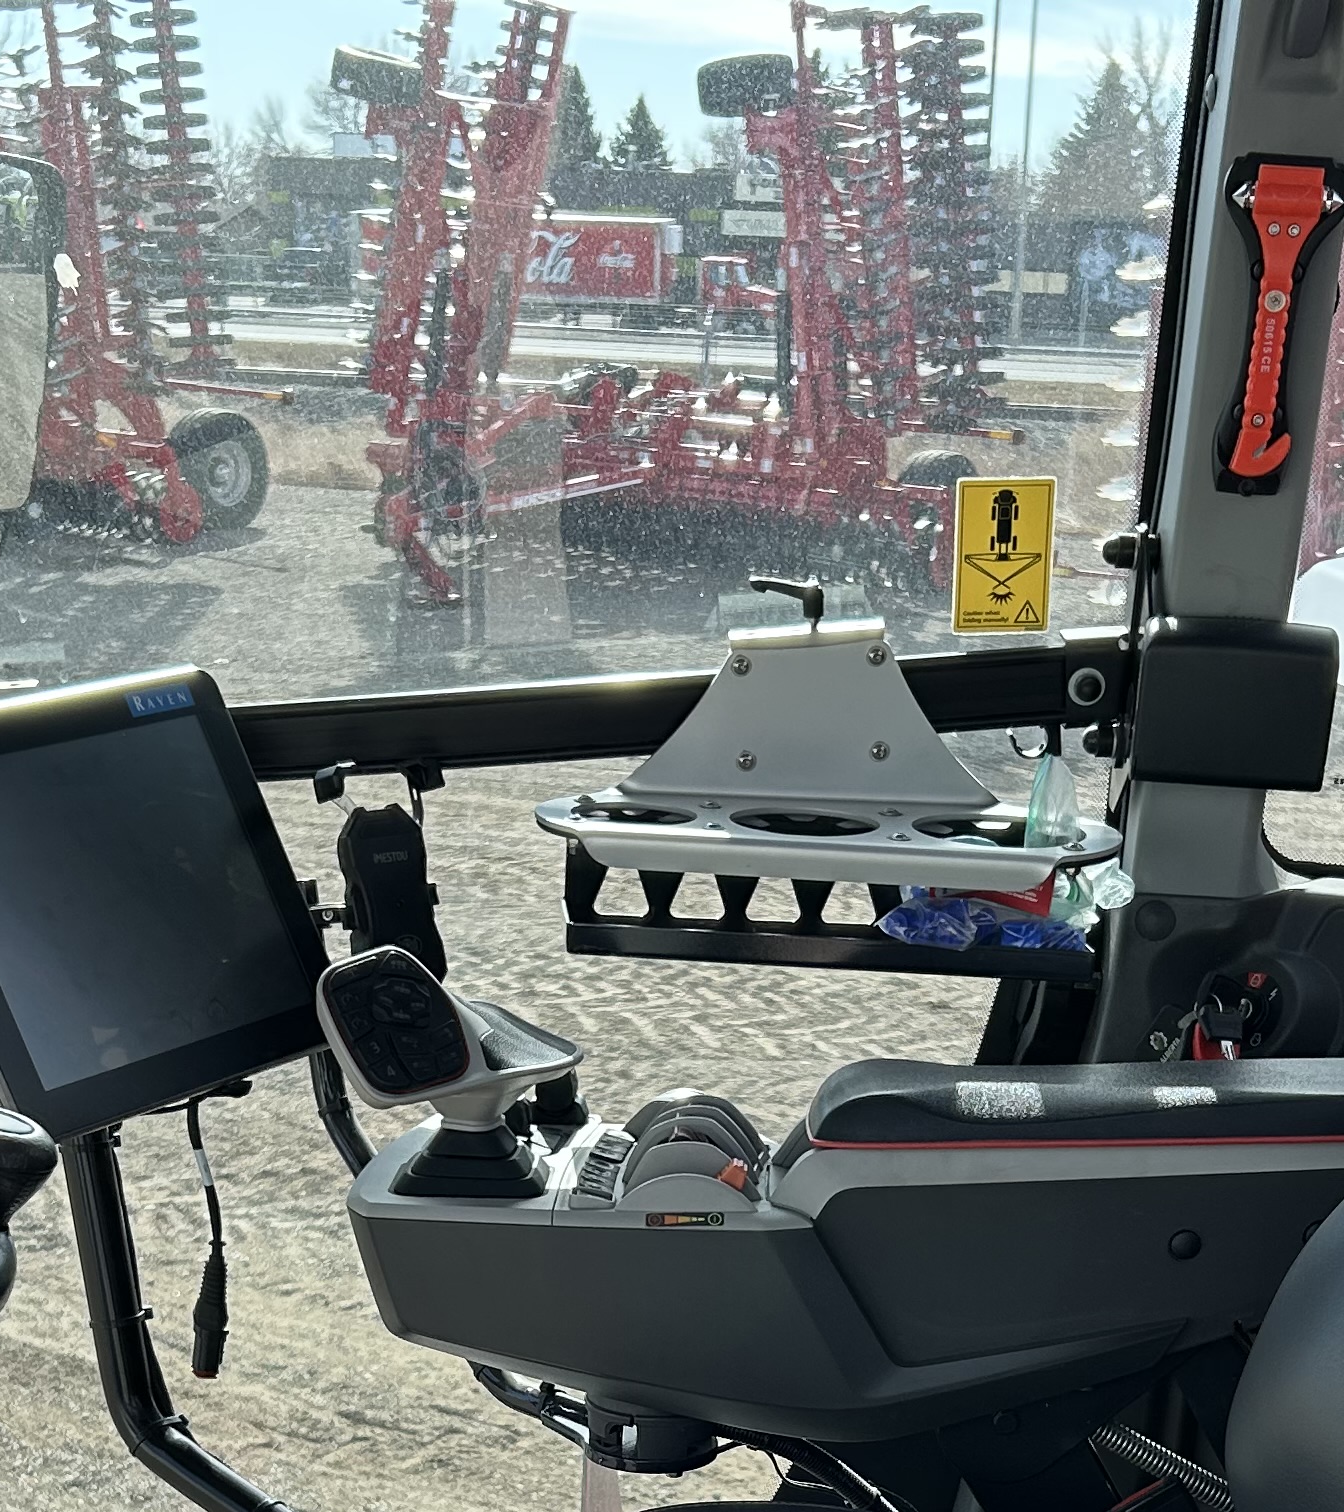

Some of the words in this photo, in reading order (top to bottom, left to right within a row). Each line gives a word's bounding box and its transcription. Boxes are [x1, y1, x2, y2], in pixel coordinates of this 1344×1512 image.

[1260, 356, 1272, 373] CE
[132, 690, 188, 712] RAVEN
[369, 1041, 381, 1054] 3
[387, 1065, 396, 1077] 4
